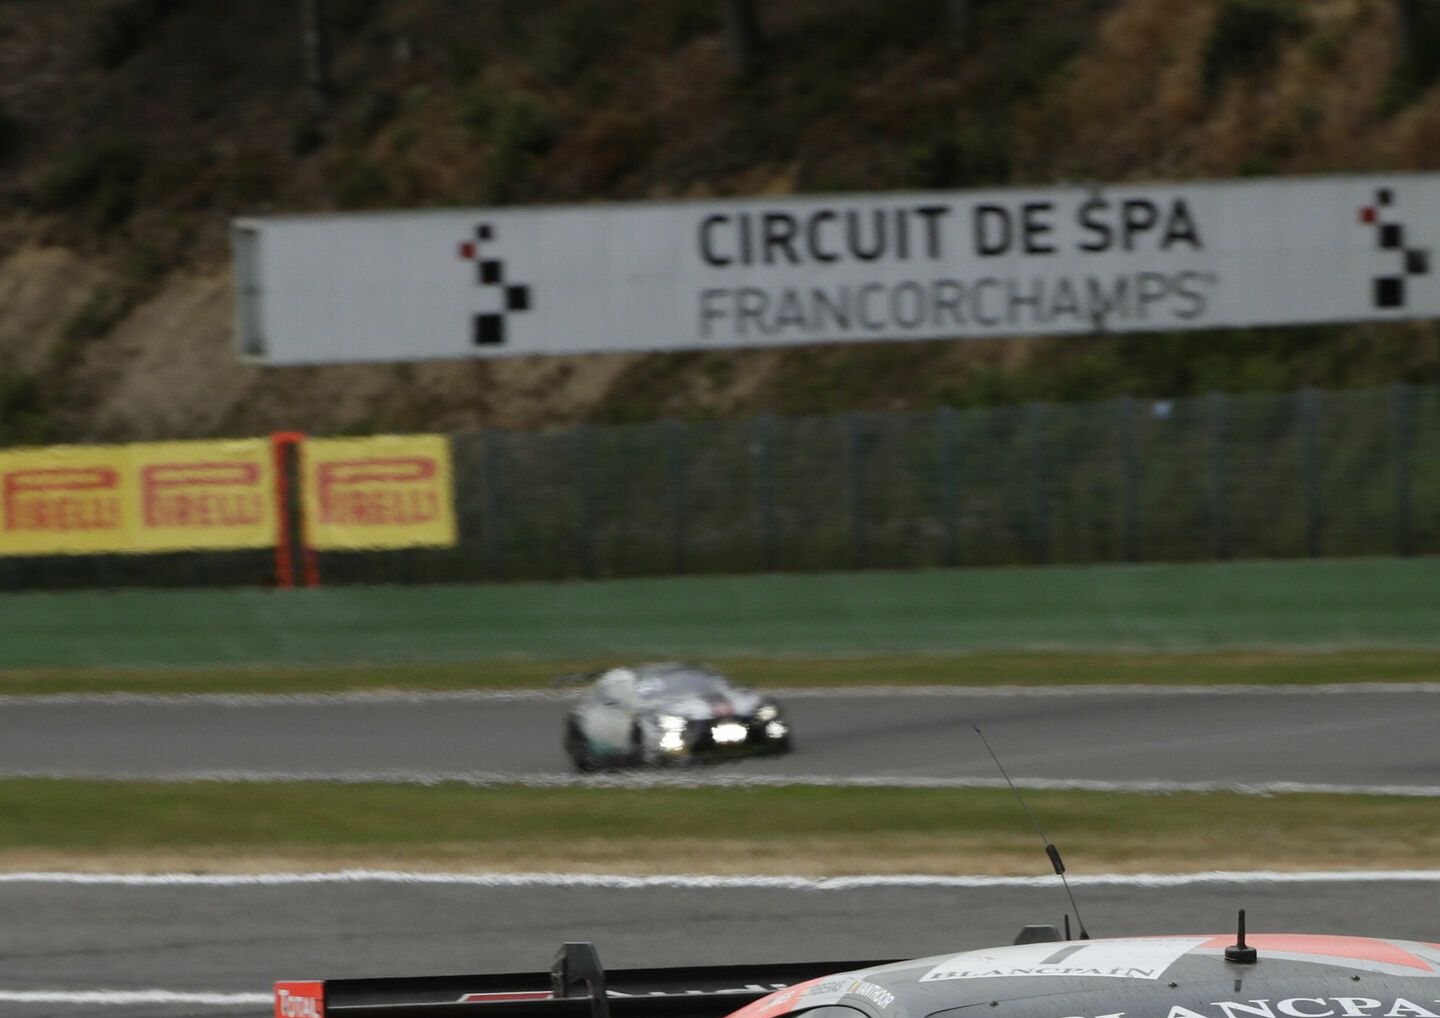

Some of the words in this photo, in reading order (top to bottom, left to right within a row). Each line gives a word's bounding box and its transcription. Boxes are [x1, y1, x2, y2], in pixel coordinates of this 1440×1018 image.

[701, 206, 948, 267] CIRCUIT
[975, 203, 1056, 257] DE
[1078, 198, 1201, 251] SPA
[700, 270, 1208, 337] FRANCORCHAMPS
[931, 967, 1156, 981] BLANCPAIN
[277, 989, 321, 1018] TOTAL
